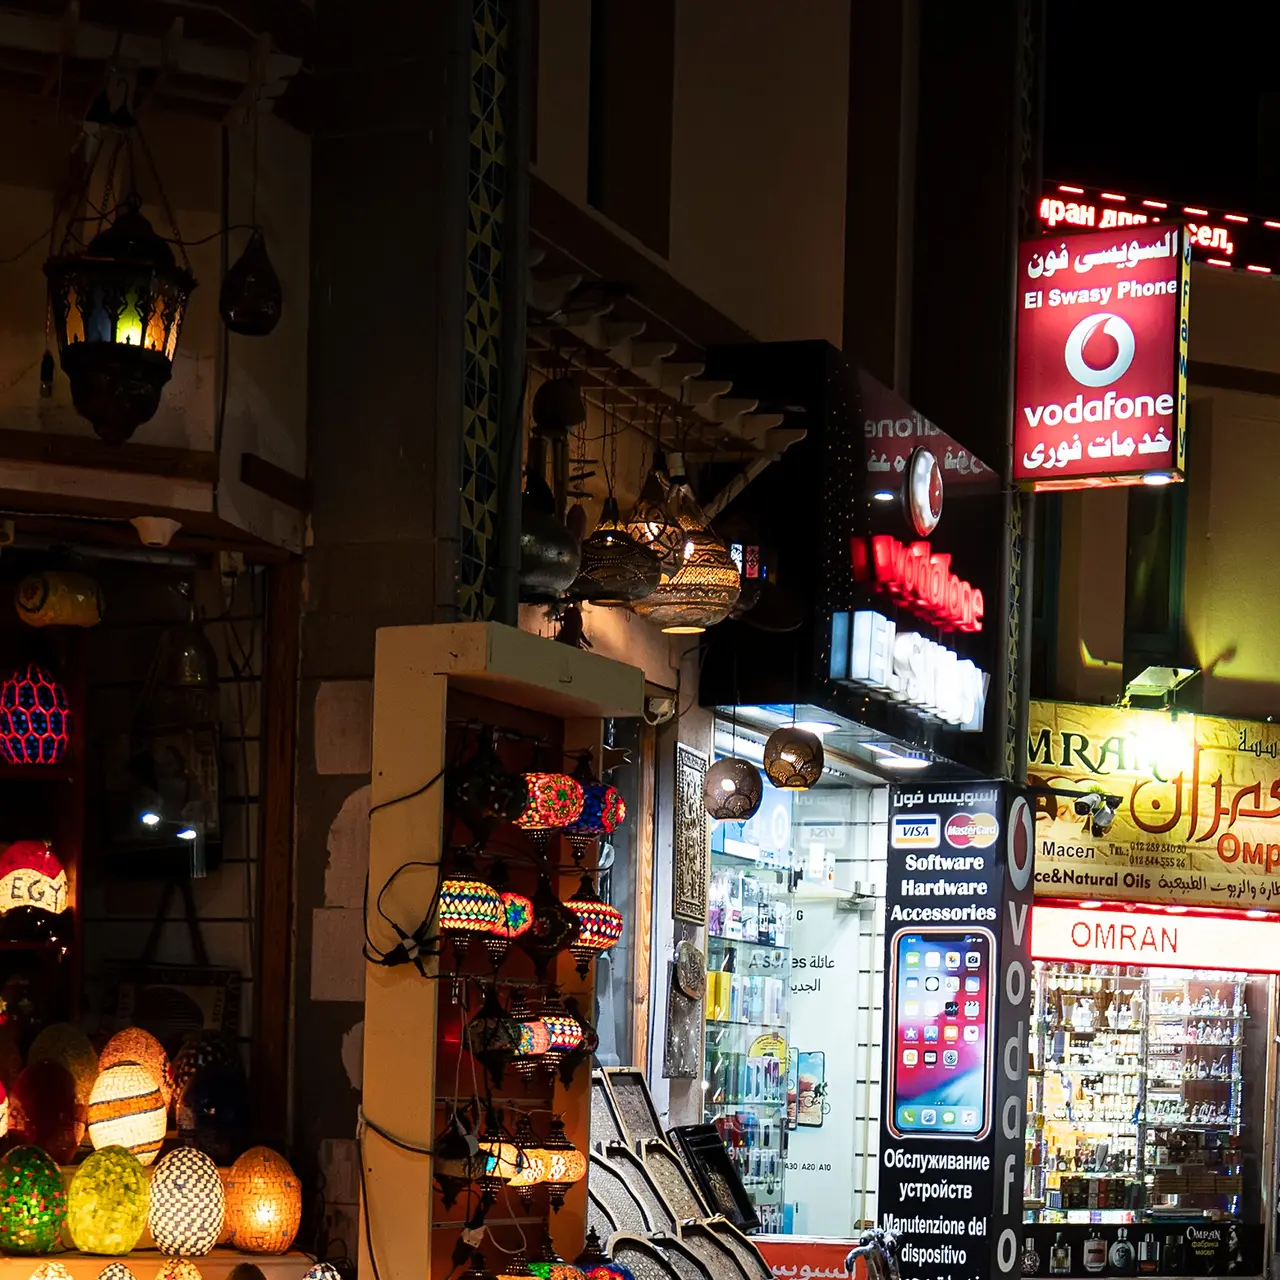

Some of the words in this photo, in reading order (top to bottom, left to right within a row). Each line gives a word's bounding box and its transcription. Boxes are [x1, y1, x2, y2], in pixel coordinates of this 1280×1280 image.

[1027, 243, 1069, 279] فون
[1024, 291, 1042, 309] El
[1048, 285, 1112, 307] Swasy
[1117, 279, 1177, 300] Phone
[1024, 390, 1174, 428] vodafone
[1087, 427, 1172, 459] خدمات
[893, 790, 924, 808] فون
[902, 826, 929, 837] VISA
[947, 824, 996, 836] MasterCard
[1042, 841, 1095, 859] Масел
[905, 854, 985, 871] Software
[901, 879, 988, 896] Hardware
[1123, 872, 1151, 888] Oils
[890, 903, 997, 921] Accessories
[1071, 921, 1177, 953] OMRAN
[801, 1163, 816, 1171] A20
[884, 1148, 990, 1173] Обслуживание
[899, 1179, 973, 1202] устройств
[883, 1213, 966, 1236] Manutenzione
[968, 1216, 987, 1236] del
[901, 1243, 967, 1267] dispositivo
